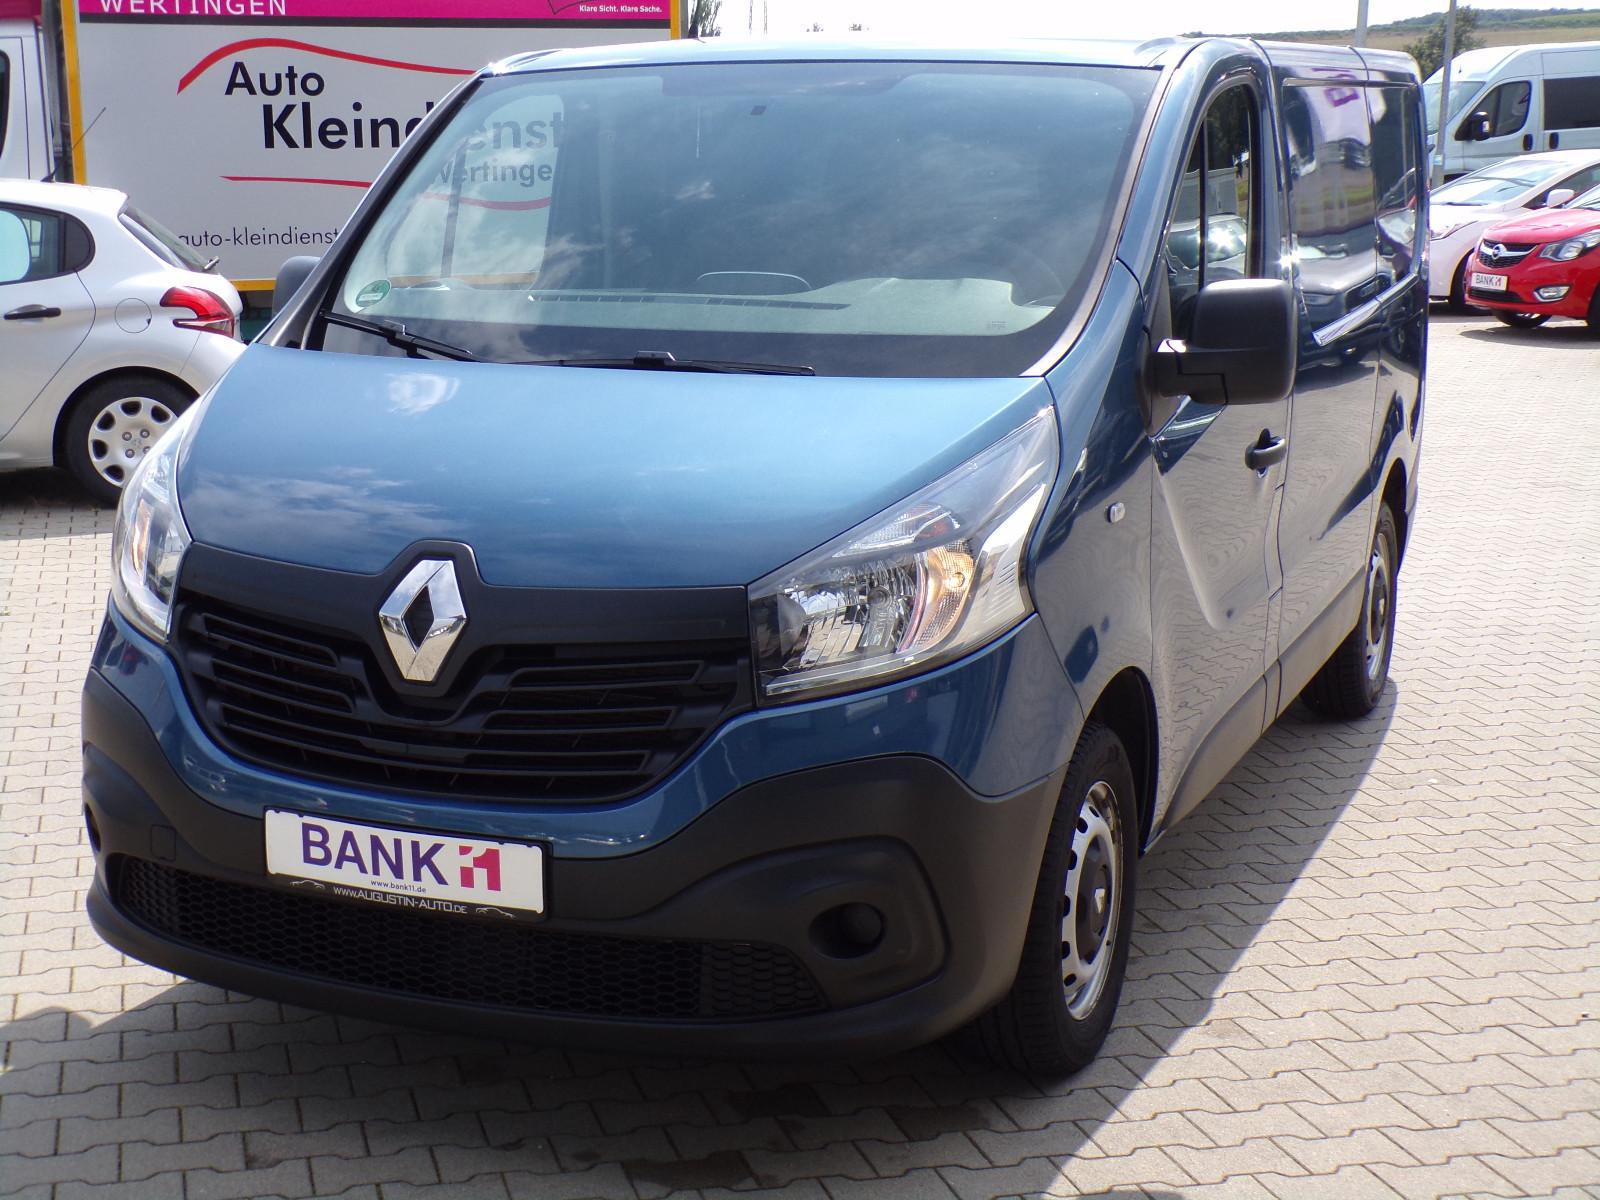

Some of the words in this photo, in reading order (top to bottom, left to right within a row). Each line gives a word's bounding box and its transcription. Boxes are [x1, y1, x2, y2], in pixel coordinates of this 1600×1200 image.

[101, 0, 286, 15] WERTINGEN
[599, 5, 619, 13] Sicht.
[640, 5, 662, 13] Sache.
[224, 61, 325, 96] Auto
[301, 822, 449, 886] BANK
[370, 879, 427, 893] www.bank11.de
